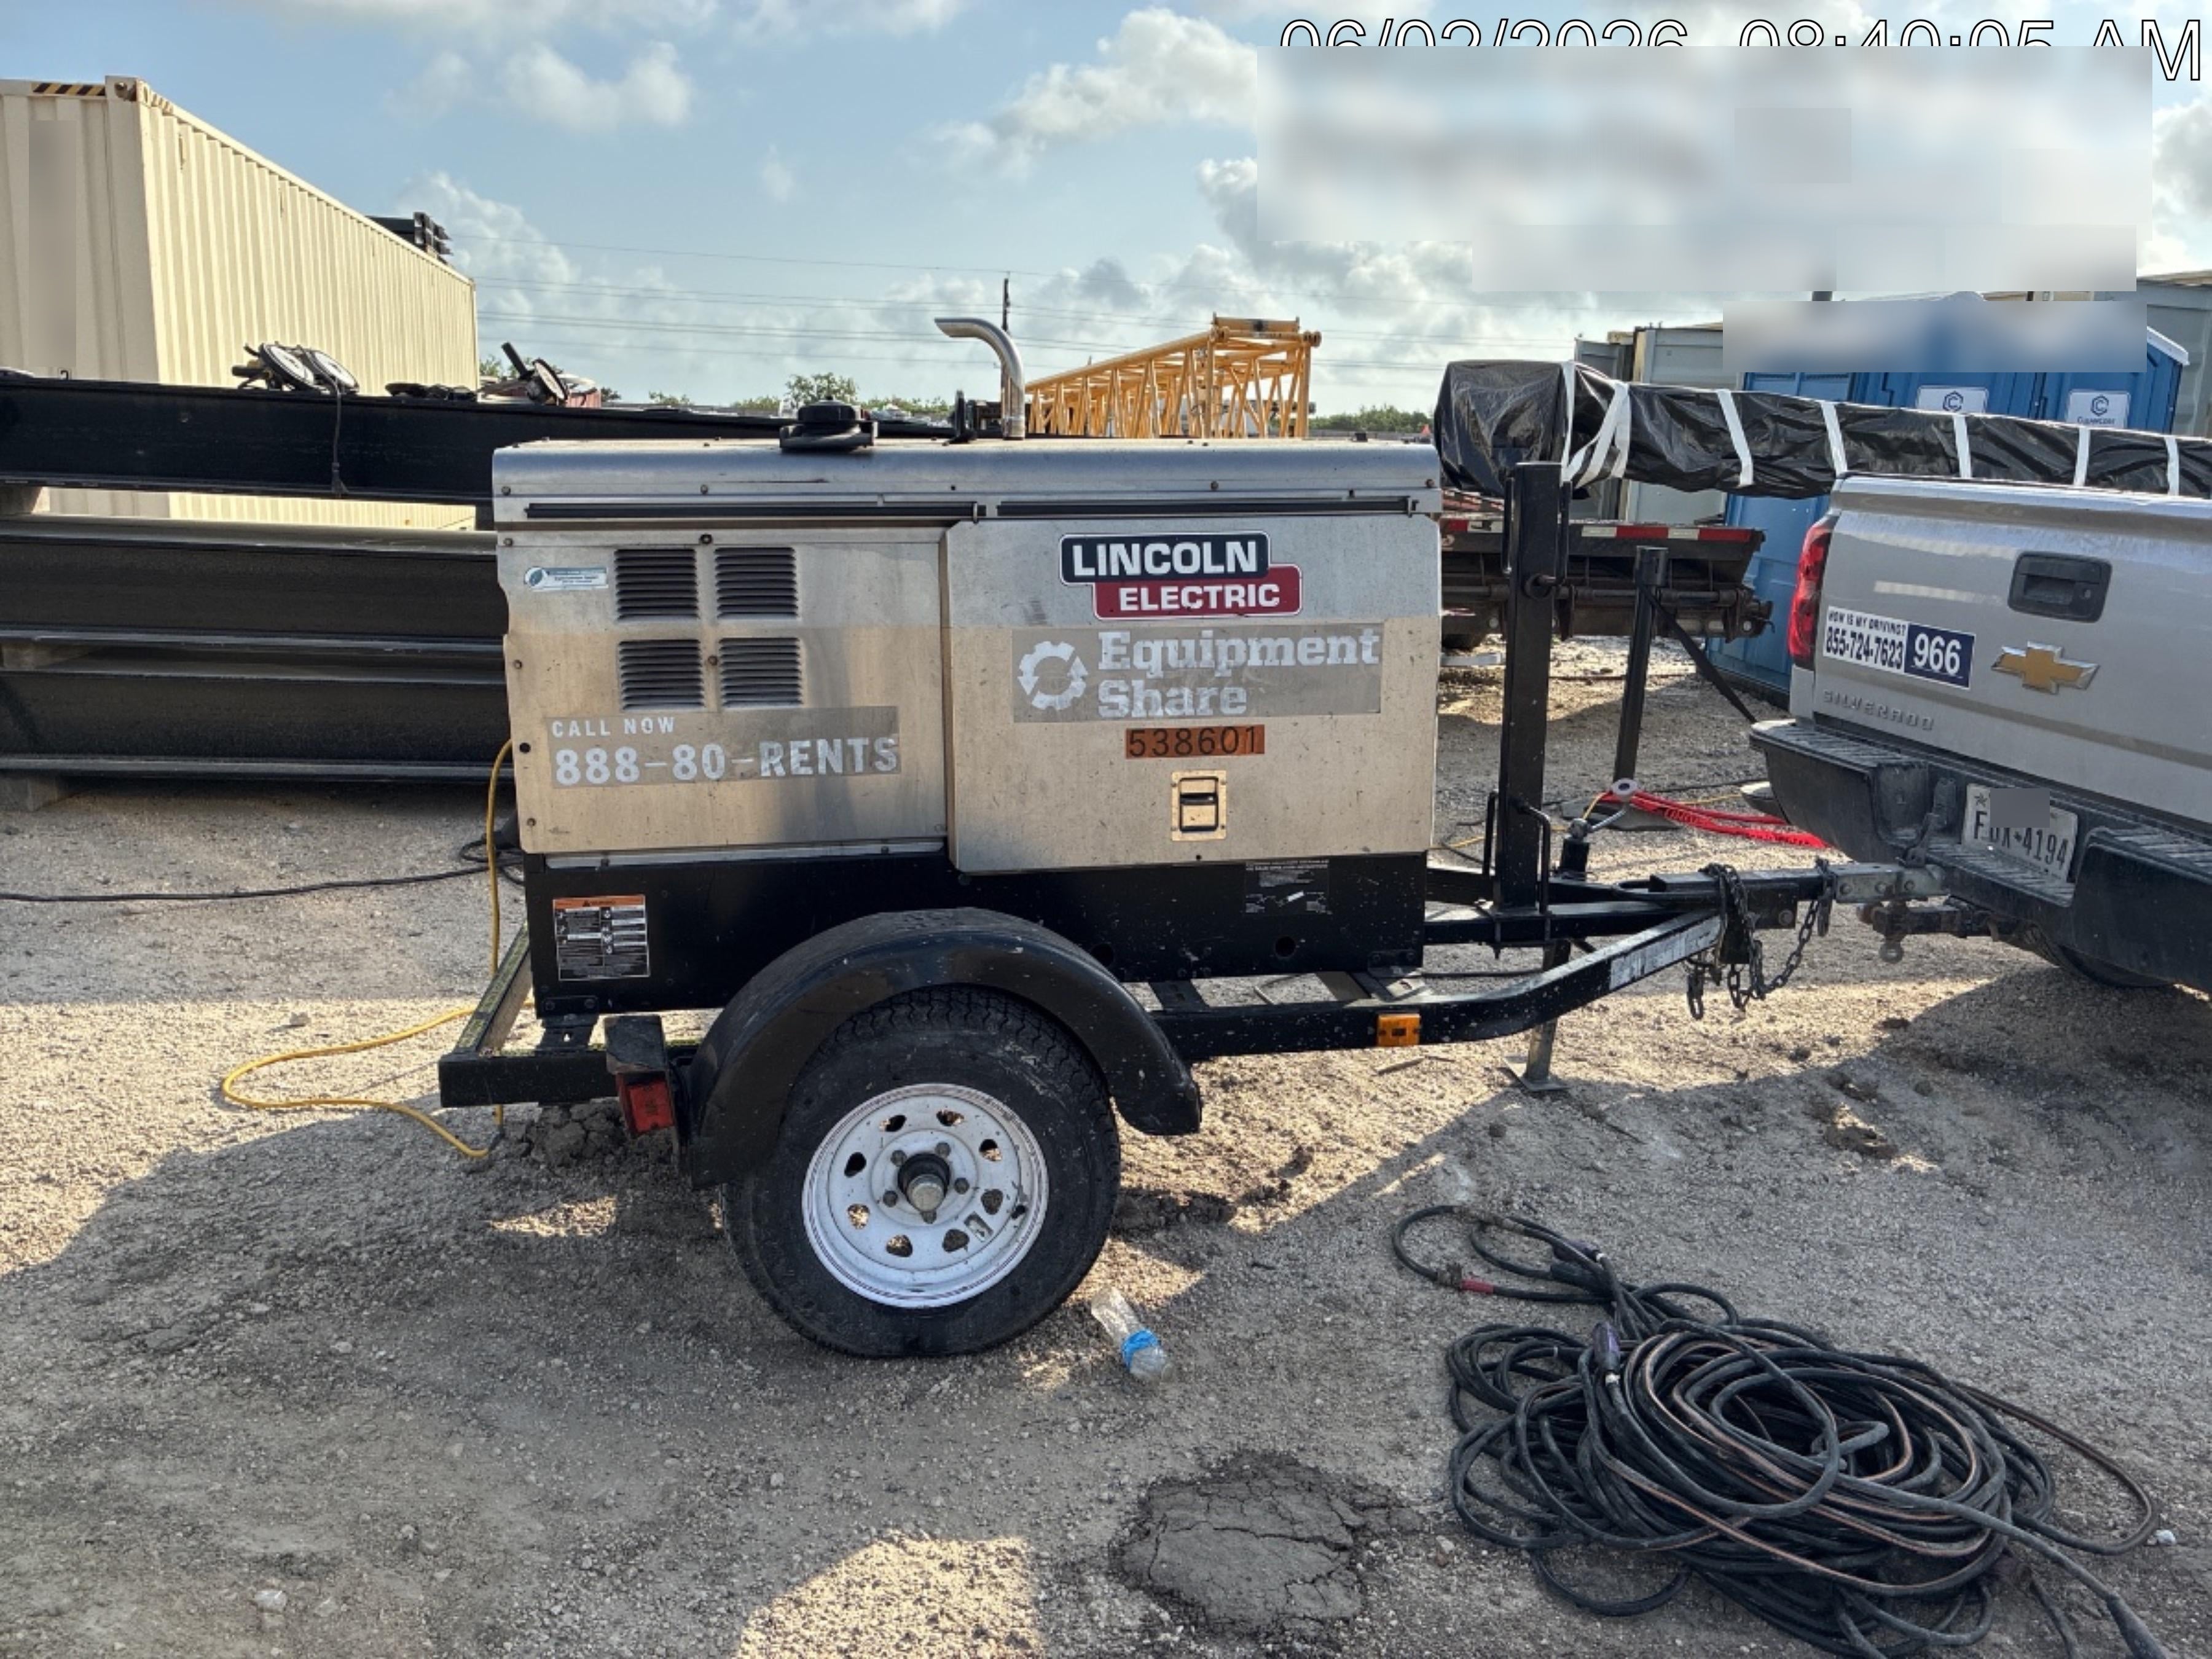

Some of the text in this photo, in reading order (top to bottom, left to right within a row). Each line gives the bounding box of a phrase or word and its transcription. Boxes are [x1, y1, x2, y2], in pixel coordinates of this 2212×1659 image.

[1072, 541, 1257, 576] LINCOLN
[1120, 584, 1281, 611] ELECTRIC
[1847, 613, 1854, 626] IS
[1856, 616, 1867, 628] MY
[1098, 628, 1380, 679] Equipment
[1826, 626, 1904, 670] 855-724-7623
[1913, 633, 1962, 675] 966
[1098, 679, 1247, 718] Share
[1824, 689, 1934, 731] SILVERADO
[552, 716, 675, 737] CALL NOW
[1129, 726, 1258, 756] 538601
[555, 737, 898, 786] 888-80-RENTS
